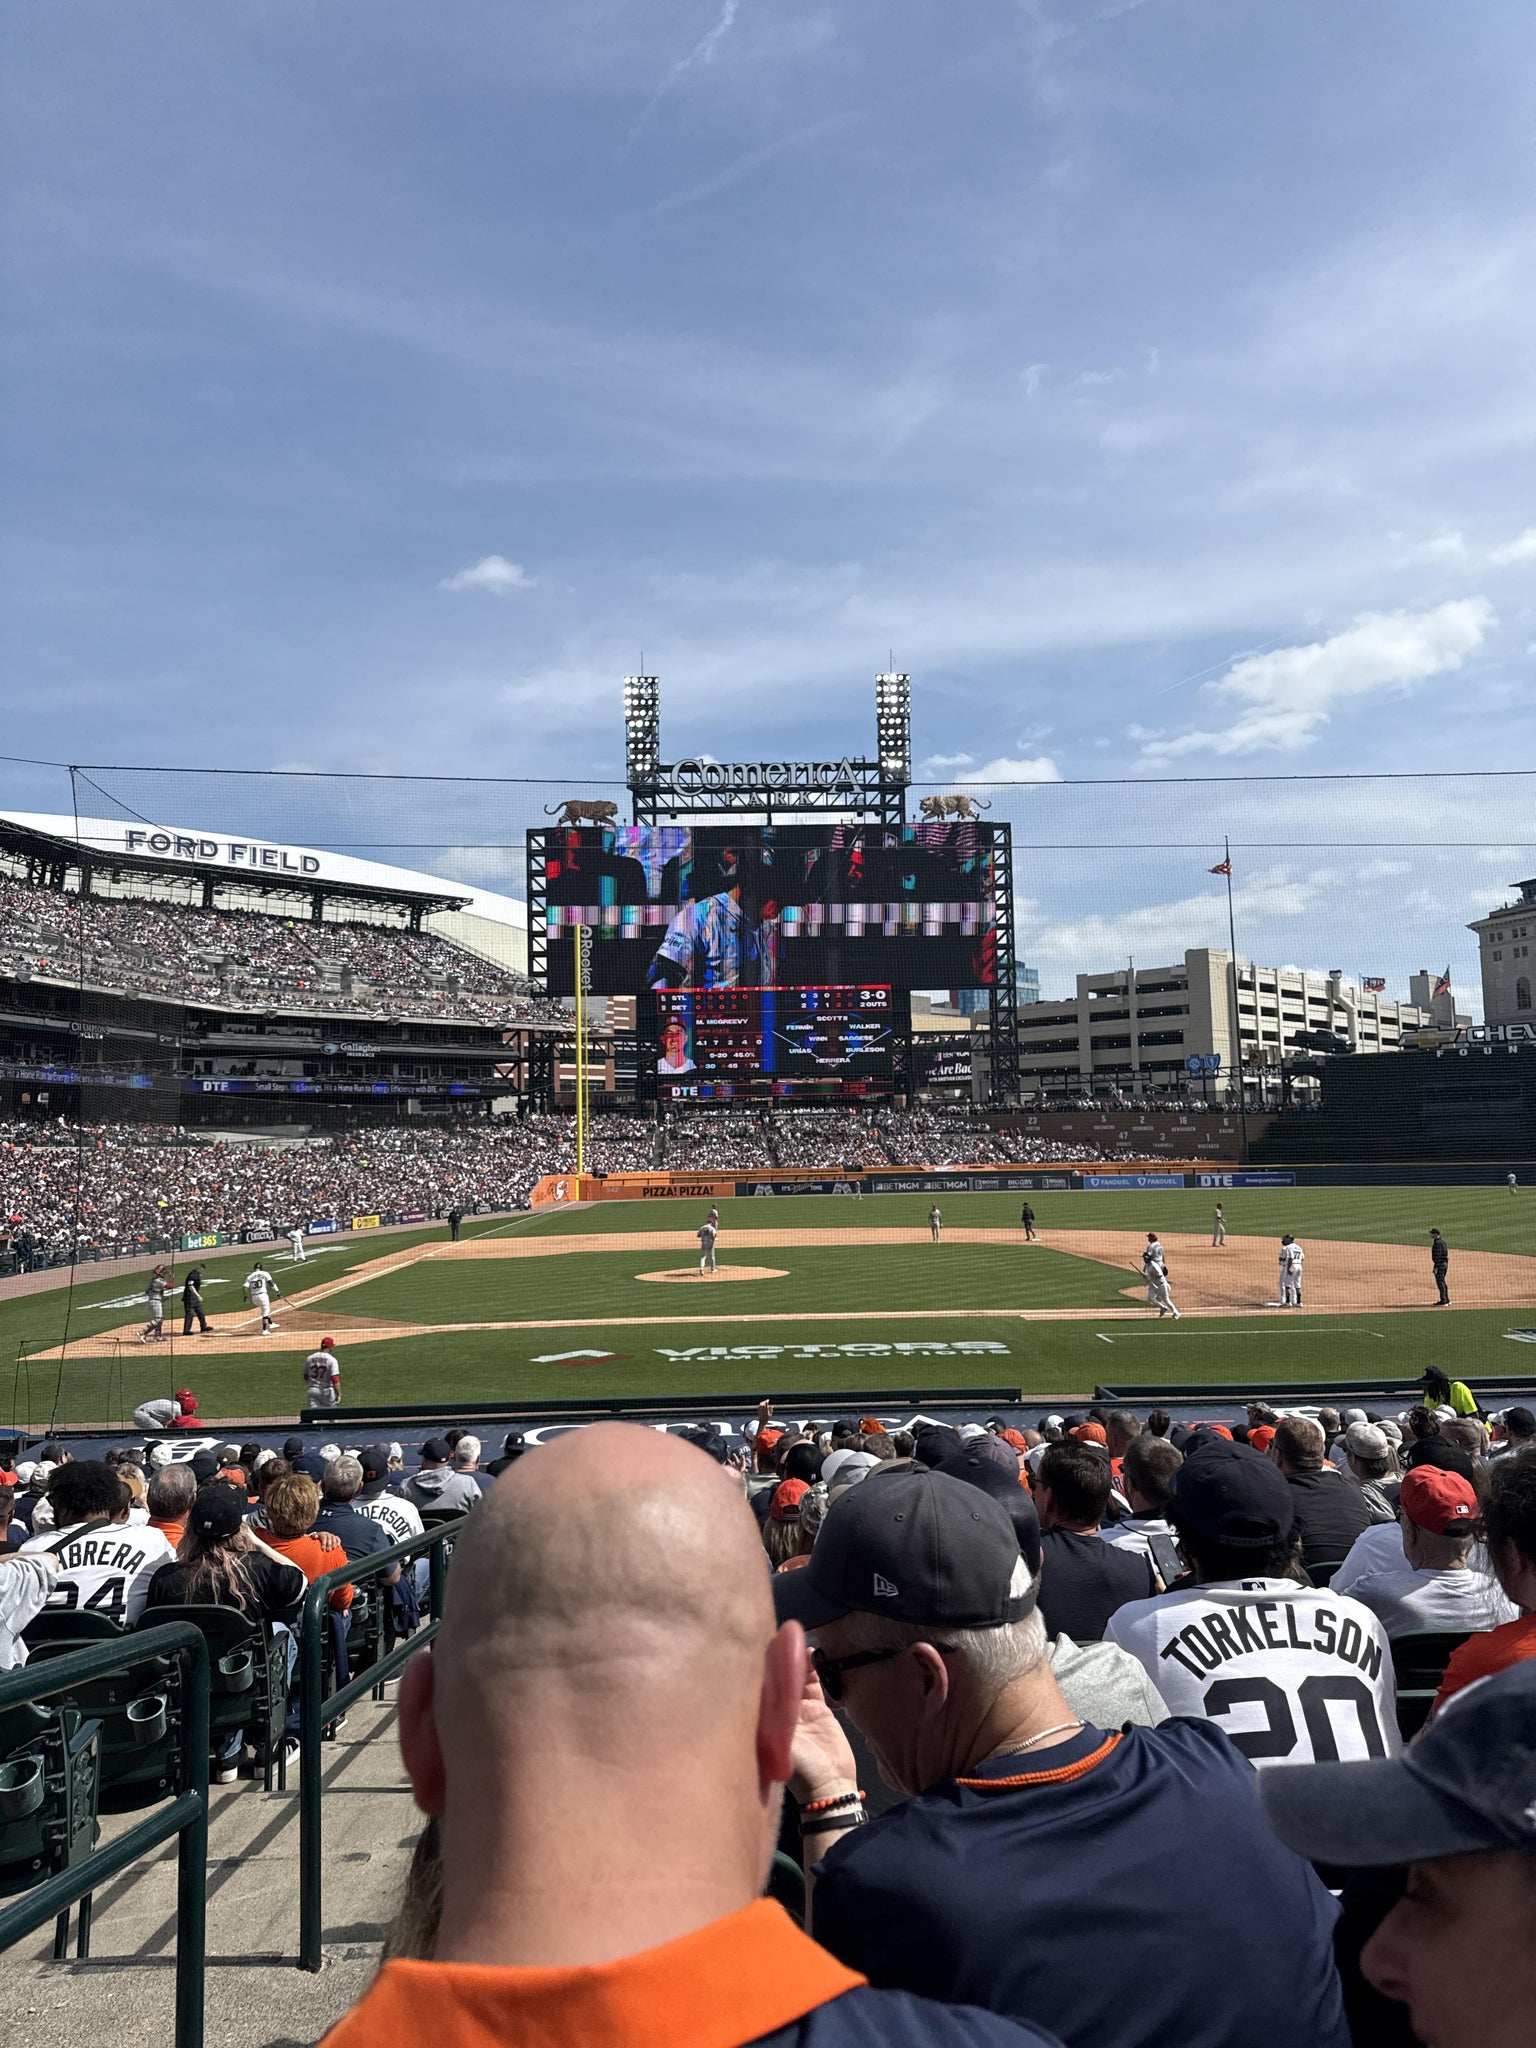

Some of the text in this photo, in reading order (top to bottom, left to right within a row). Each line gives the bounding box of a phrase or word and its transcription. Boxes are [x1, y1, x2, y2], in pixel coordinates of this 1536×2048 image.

[725, 791, 812, 806] PARK
[126, 829, 320, 875] FORD FIELD
[581, 940, 593, 990] Rocket
[860, 990, 886, 1000] 3-0
[340, 1043, 381, 1053] Gallagher
[938, 1064, 954, 1075] Are
[955, 1063, 972, 1074] Bac
[203, 1081, 229, 1091] DTE
[338, 1084, 353, 1092] Home
[672, 1086, 698, 1096] DTE
[1028, 1117, 1037, 1125] 23
[1101, 1115, 1106, 1123] 5
[1140, 1116, 1145, 1124] 2
[1179, 1116, 1188, 1125] 16
[1223, 1117, 1229, 1126] 6
[1119, 1131, 1128, 1140] 47
[1160, 1132, 1166, 1141] 3
[1206, 1133, 1210, 1142] 1
[883, 1182, 919, 1190] BETMGM
[932, 1181, 968, 1190] BETMGM
[1201, 1175, 1233, 1187] DTE
[643, 1186, 713, 1197] PIZZA! PIZZA!
[188, 1235, 217, 1248] bet365
[251, 1279, 263, 1289] 30
[652, 1341, 1007, 1356] VICTORS
[793, 1350, 1012, 1358] SOLUTIONS
[311, 1364, 327, 1379] 37
[357, 1505, 412, 1538] DERSON
[57, 1541, 146, 1575] ABRERA
[1160, 1603, 1382, 1681] TORKELSON
[1204, 1675, 1387, 1763] 20
